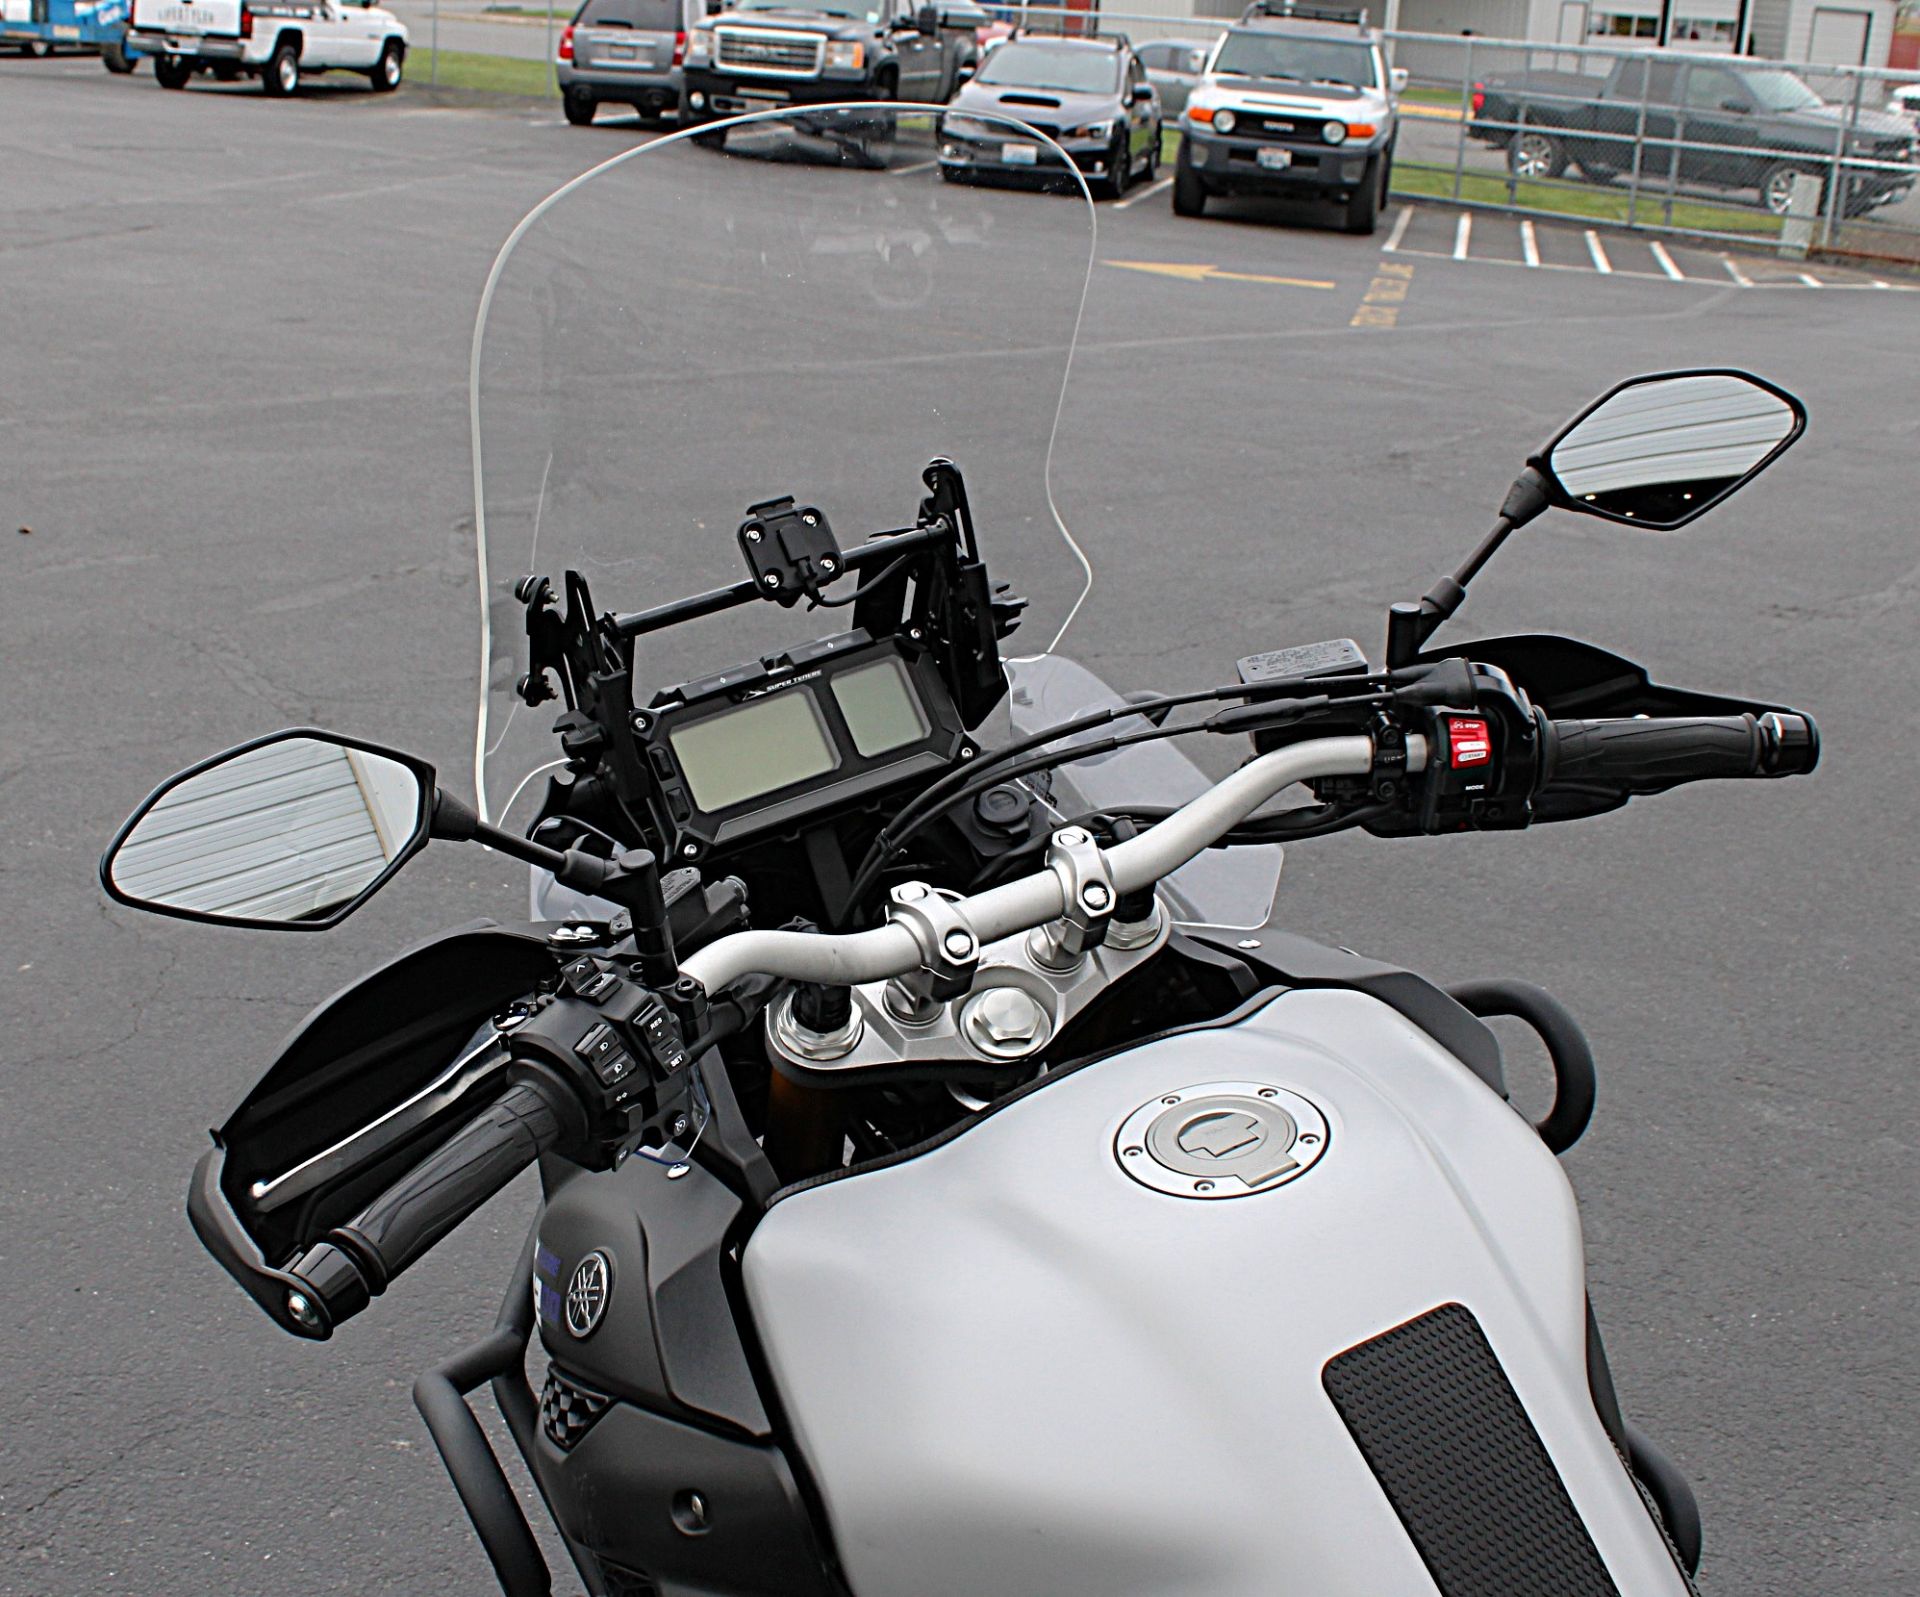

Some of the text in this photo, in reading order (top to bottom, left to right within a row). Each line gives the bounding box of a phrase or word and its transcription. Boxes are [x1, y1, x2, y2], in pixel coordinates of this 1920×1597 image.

[766, 679, 792, 692] SUPER
[650, 1017, 663, 1030] RES
[670, 1054, 683, 1067] SET
